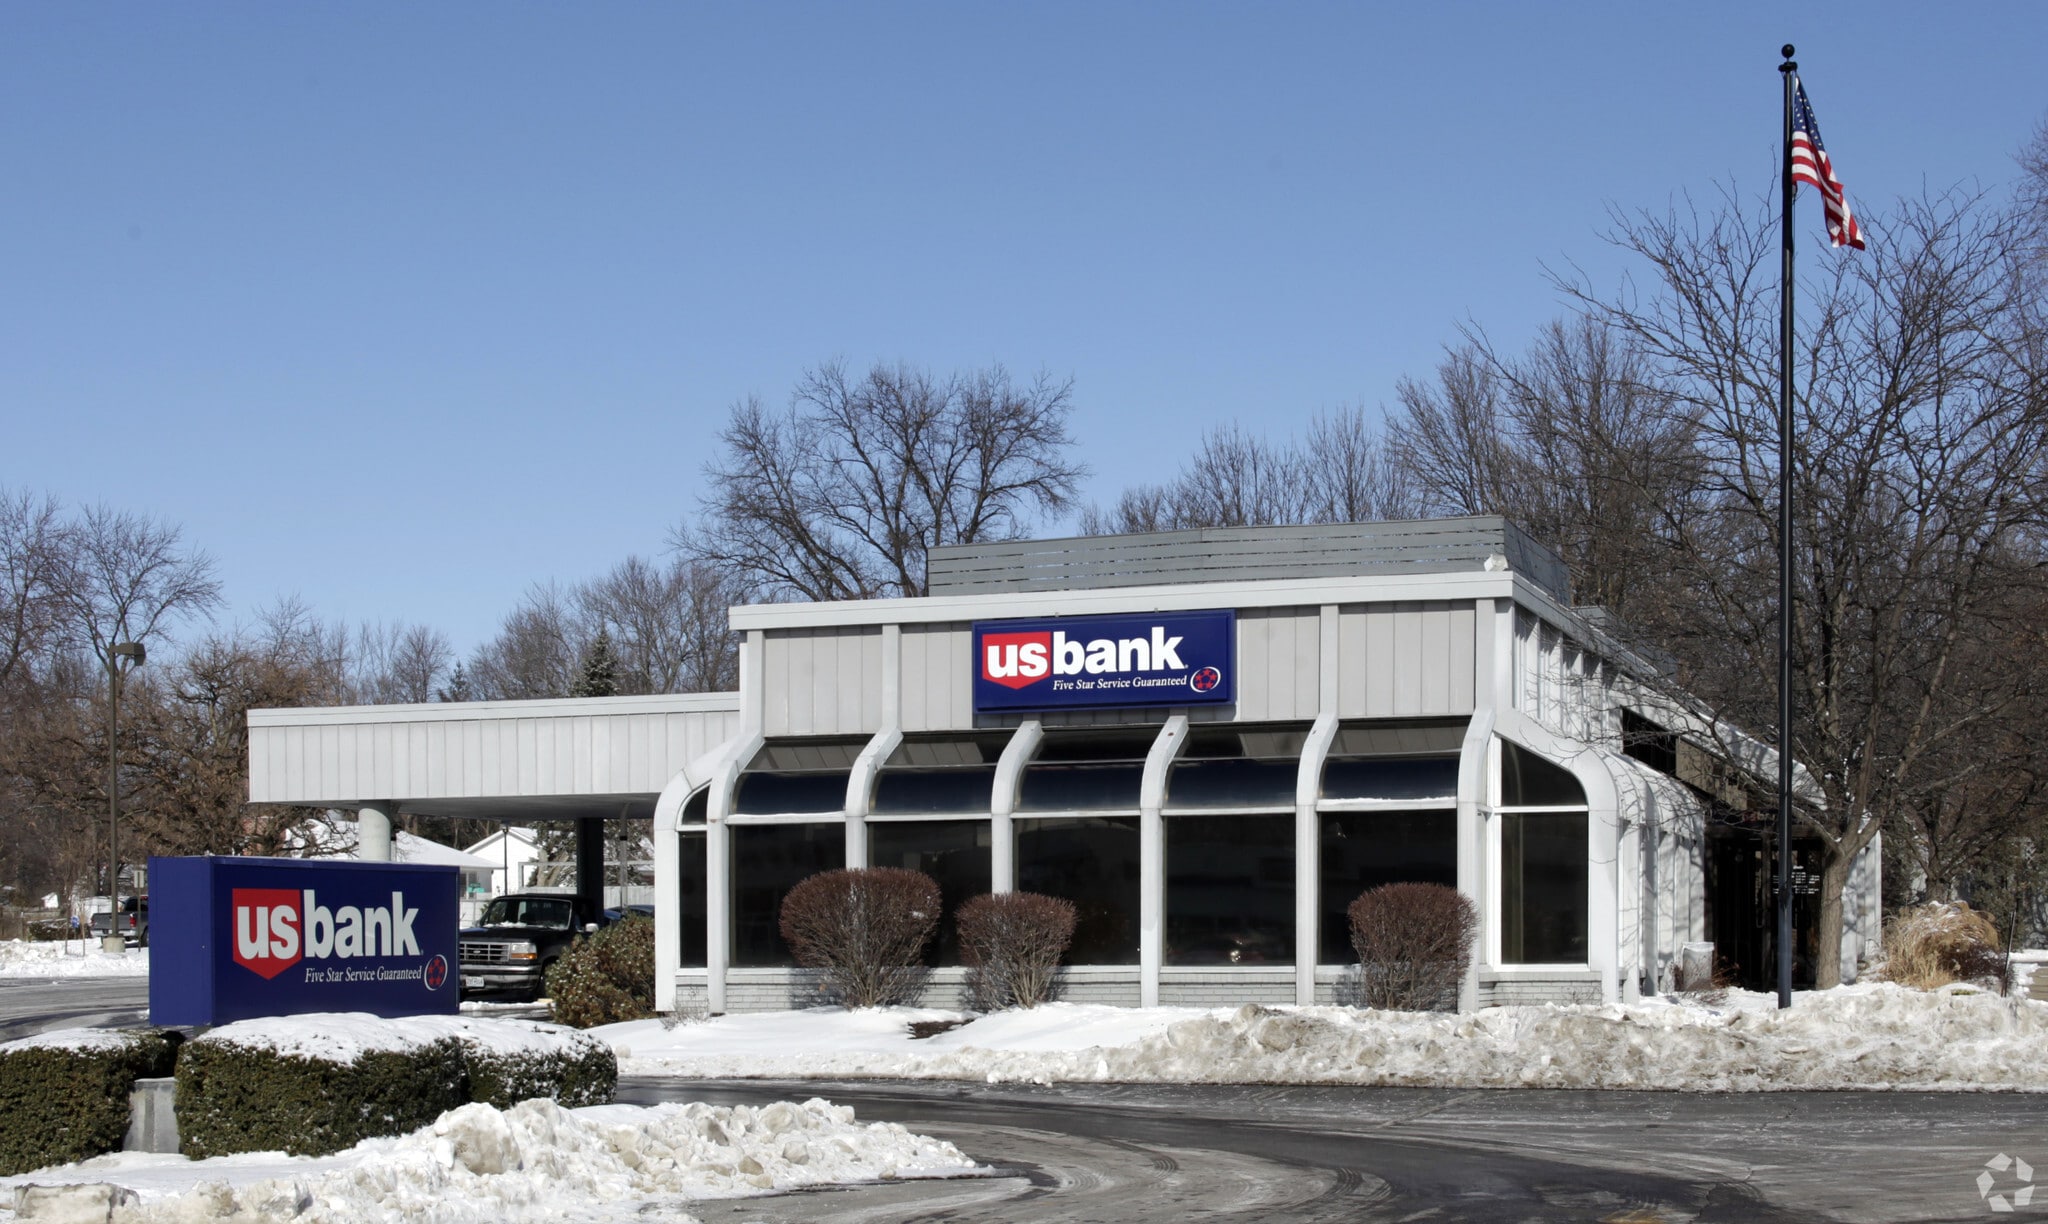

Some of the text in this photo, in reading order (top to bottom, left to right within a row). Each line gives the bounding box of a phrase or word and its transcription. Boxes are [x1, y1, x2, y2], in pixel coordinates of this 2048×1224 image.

[1053, 675, 1188, 690] Five Star Service Guaranteed
[305, 965, 423, 983] Five Star Service Guaranteed
